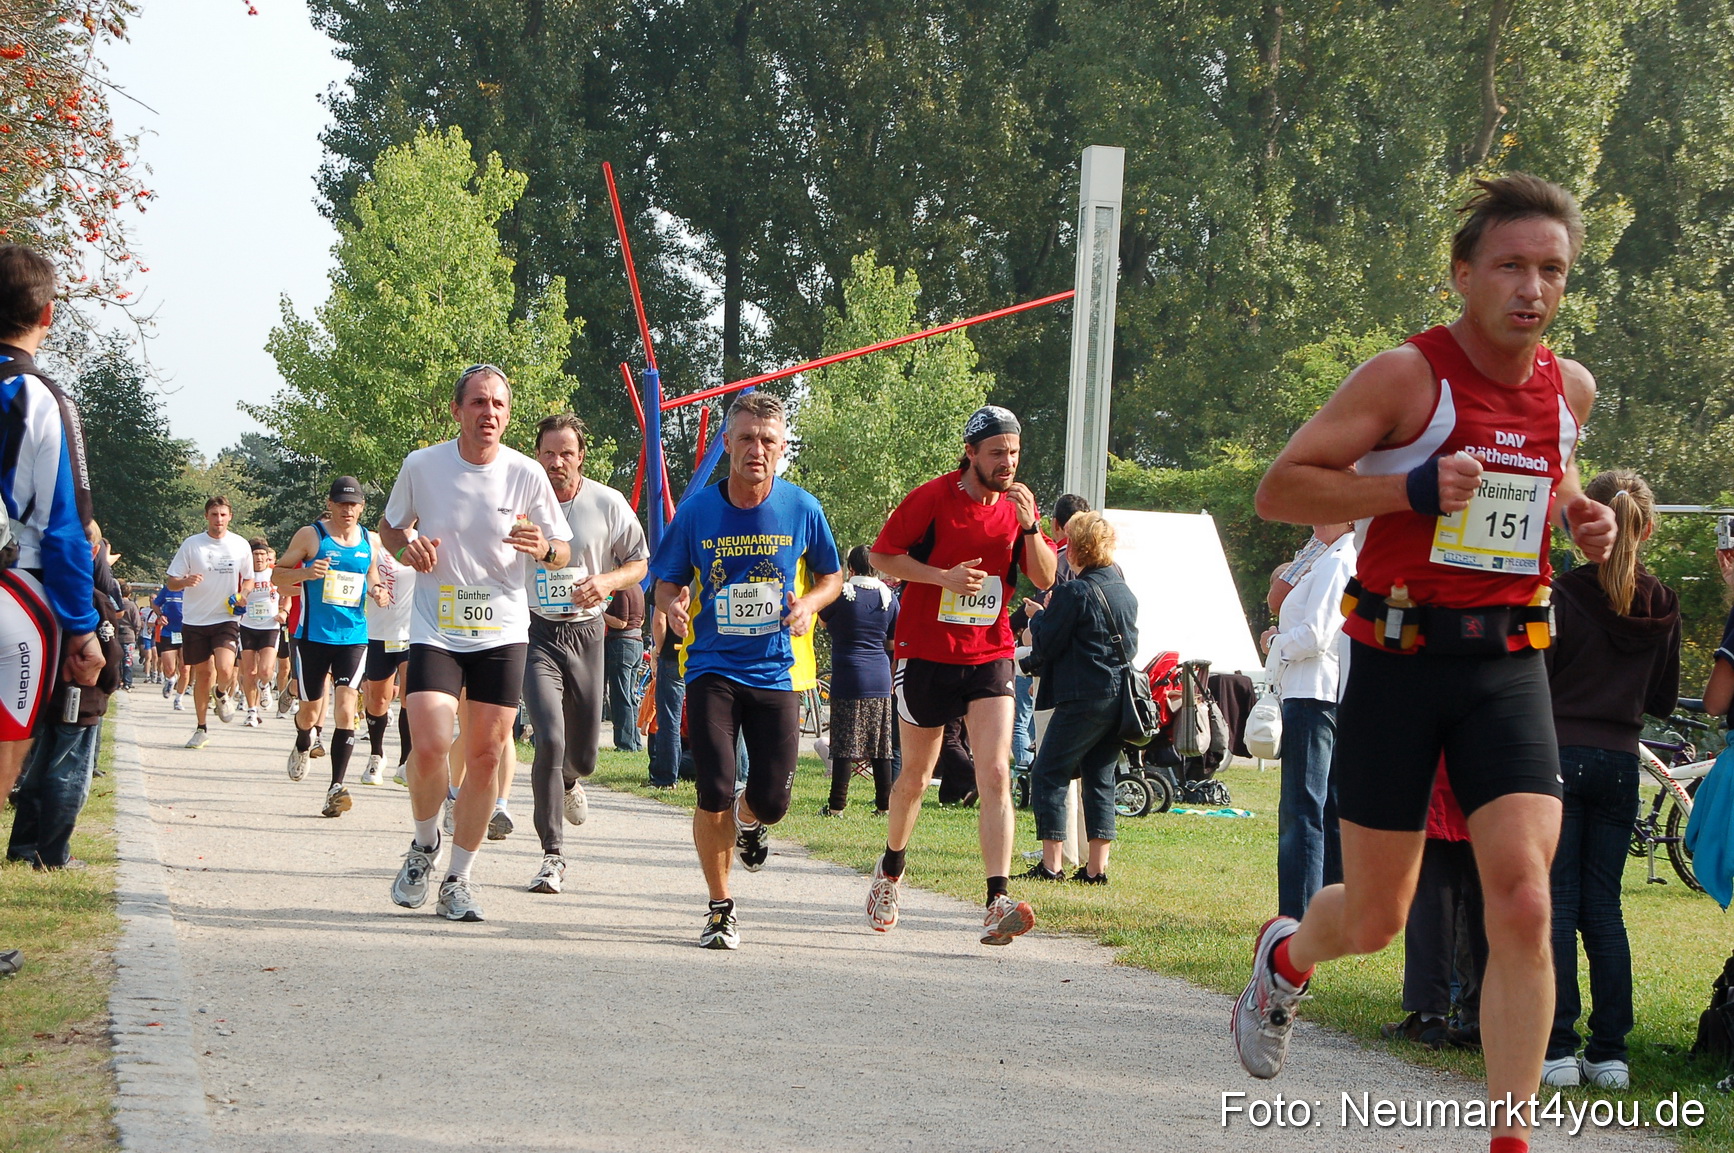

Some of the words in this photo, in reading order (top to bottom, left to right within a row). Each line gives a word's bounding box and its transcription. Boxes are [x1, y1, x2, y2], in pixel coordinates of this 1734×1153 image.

[1495, 430, 1526, 449] DAV
[1477, 479, 1538, 503] Reinhard
[1485, 511, 1530, 541] 151
[701, 539, 716, 549] 10.
[717, 534, 793, 547] NEUMARKTER
[715, 545, 779, 558] STADTLAUF
[549, 572, 574, 581] Johann
[342, 585, 355, 595] 87
[457, 589, 491, 600] Günther
[551, 585, 579, 598] 231
[732, 588, 758, 599] Rudolf
[442, 604, 447, 613] C
[959, 594, 996, 609] 1049
[463, 606, 493, 621] 500
[734, 602, 773, 617] 3270
